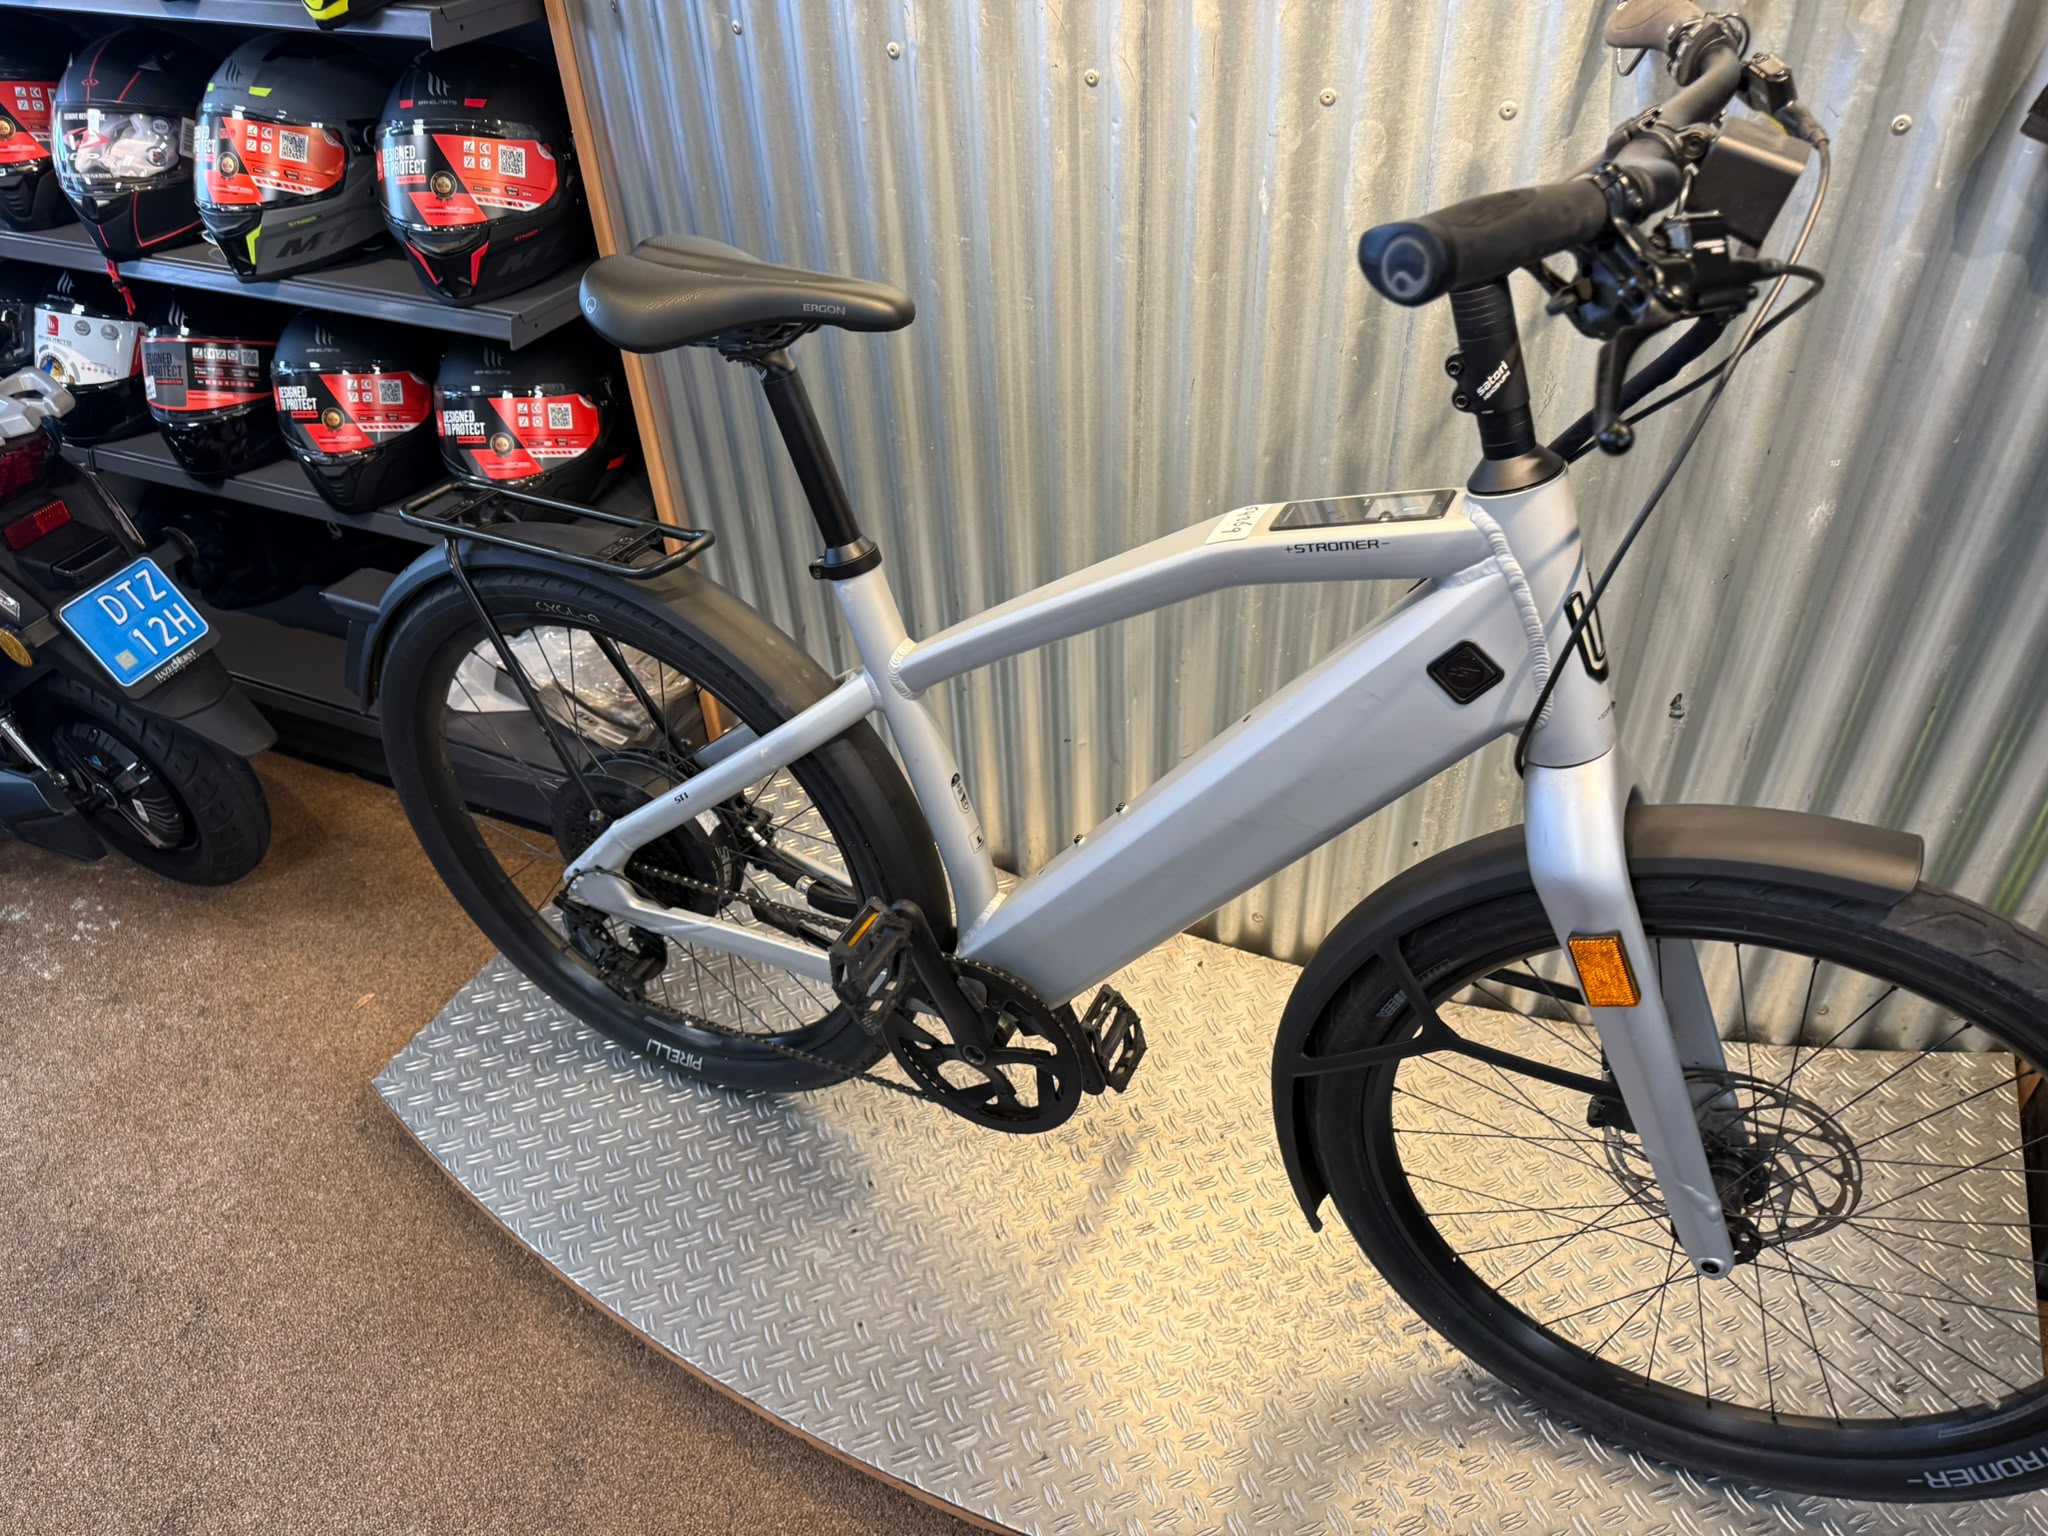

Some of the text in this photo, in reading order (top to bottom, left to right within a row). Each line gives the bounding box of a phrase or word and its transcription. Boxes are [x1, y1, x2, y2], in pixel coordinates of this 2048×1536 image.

[390, 159, 427, 177] PROTECT
[802, 303, 846, 316] ERGON
[286, 398, 317, 411] PROTECT
[443, 410, 475, 423] DESIGNED
[451, 422, 486, 436] PROTECT
[97, 569, 167, 626] DTZ
[132, 603, 197, 656] 12H
[645, 1038, 704, 1071] PIRELLI
